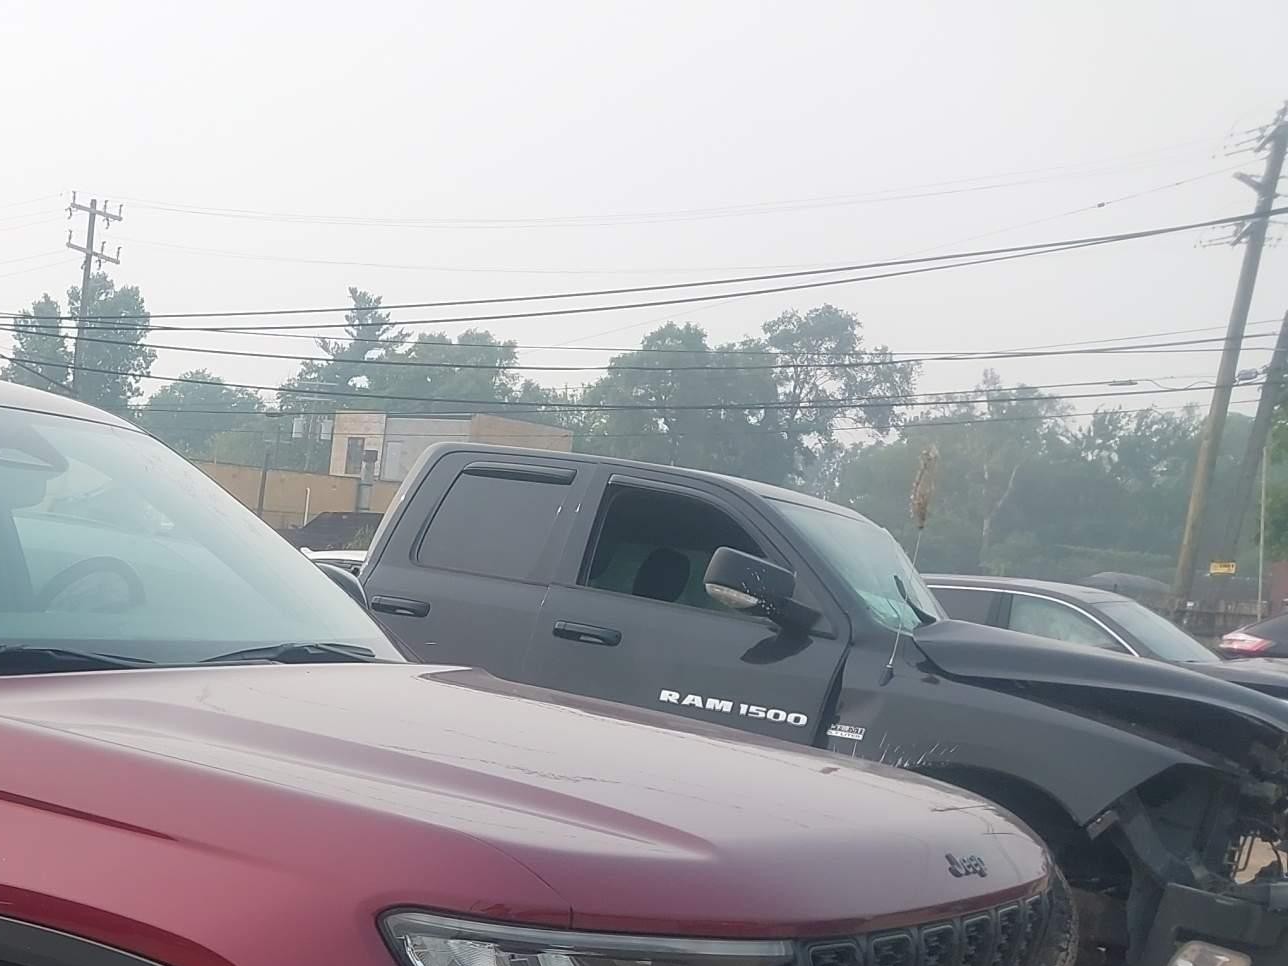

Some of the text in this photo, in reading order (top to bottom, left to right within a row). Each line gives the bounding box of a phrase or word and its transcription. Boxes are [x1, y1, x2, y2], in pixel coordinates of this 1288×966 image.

[659, 689, 808, 727] RAM 1500
[945, 853, 987, 878] Jeep
